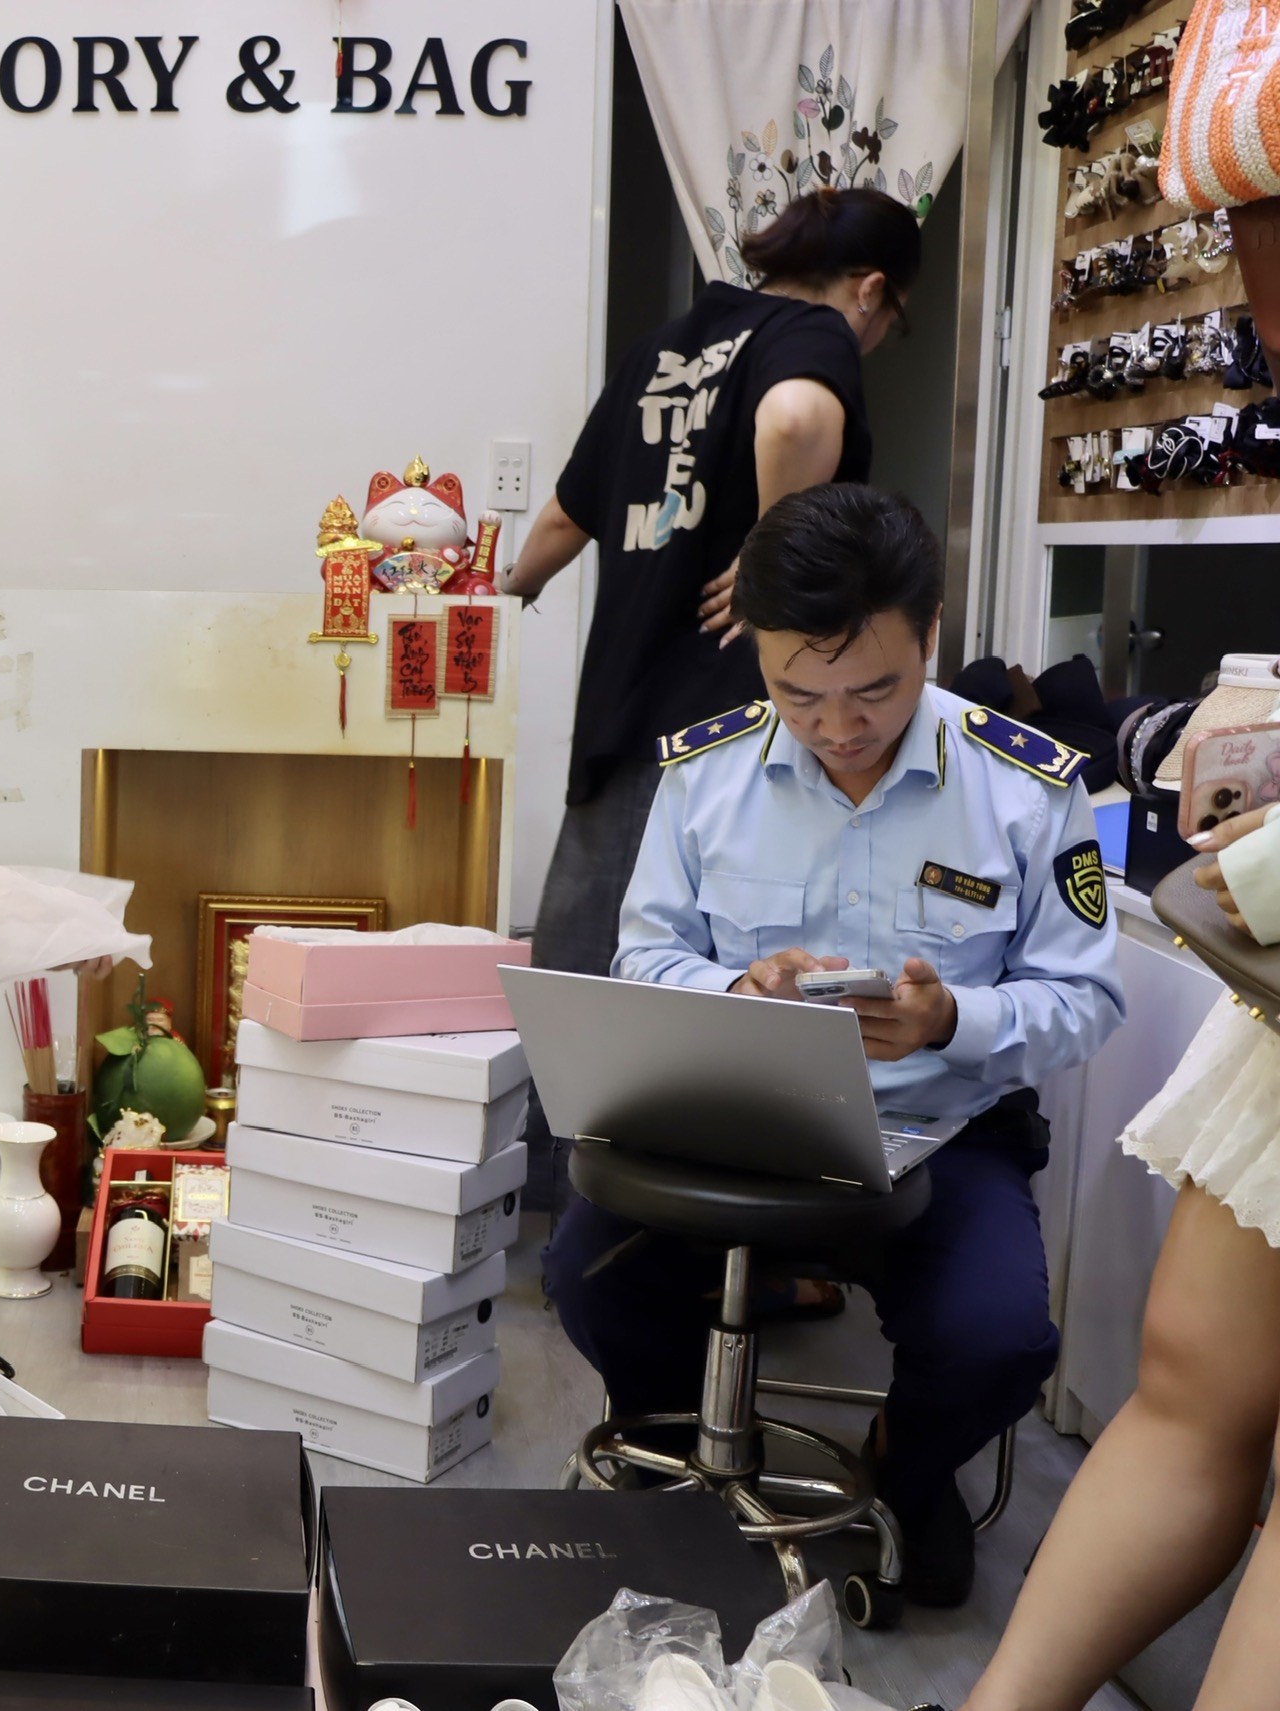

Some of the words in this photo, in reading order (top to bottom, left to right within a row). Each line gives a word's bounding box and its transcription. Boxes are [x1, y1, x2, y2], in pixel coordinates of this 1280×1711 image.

[226, 35, 301, 113] &
[330, 37, 533, 117] BAG
[1072, 850, 1099, 870] DMS
[331, 1104, 347, 1112] SHOES
[349, 1107, 381, 1117] COLLECTION
[312, 1204, 327, 1212] SHOES
[328, 1207, 358, 1219] COLLECTION
[305, 1308, 333, 1321] COLLECTION
[308, 1413, 338, 1426] COLLECTION
[23, 1476, 166, 1503] CHANEL
[468, 1543, 617, 1560] CHANEL
